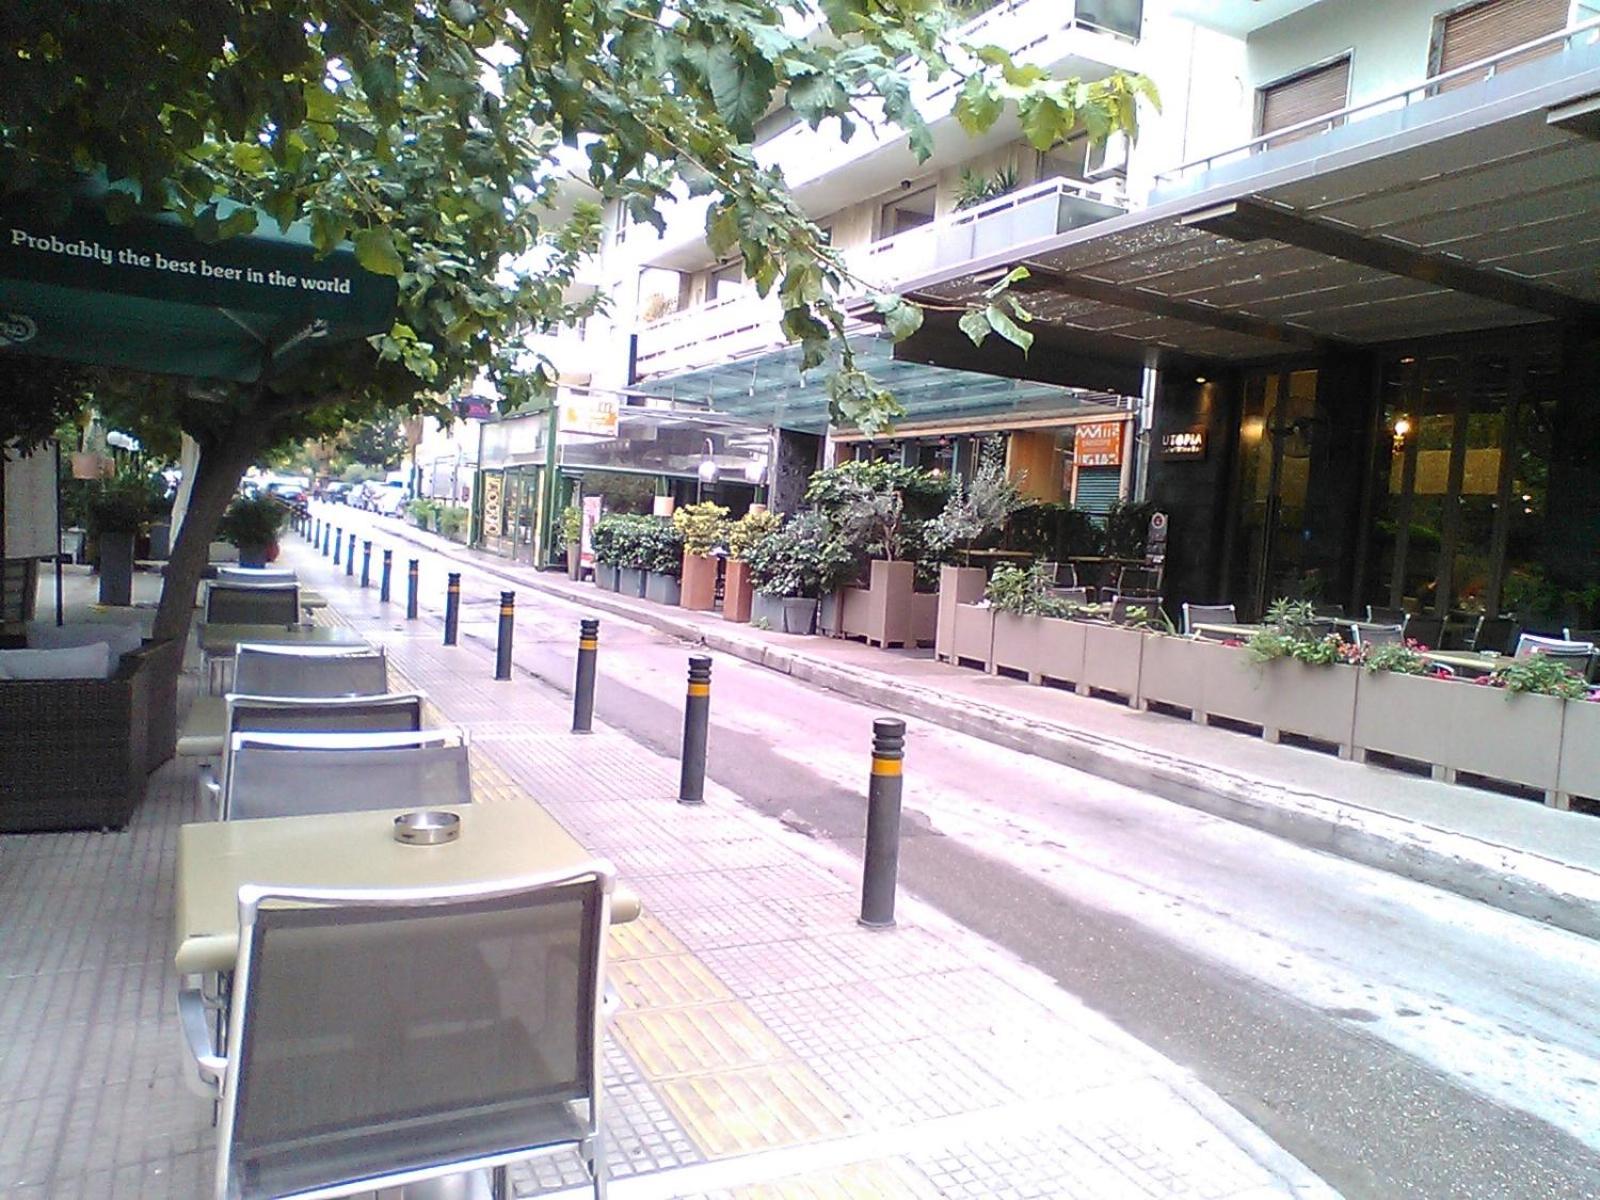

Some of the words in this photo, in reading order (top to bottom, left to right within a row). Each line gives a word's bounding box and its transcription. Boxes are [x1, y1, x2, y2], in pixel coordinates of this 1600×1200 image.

[11, 229, 112, 265] Probably
[118, 249, 151, 267] the
[155, 253, 197, 275] best
[201, 260, 243, 281] beer
[247, 267, 264, 283] in
[268, 270, 297, 288] the
[301, 278, 350, 294] world
